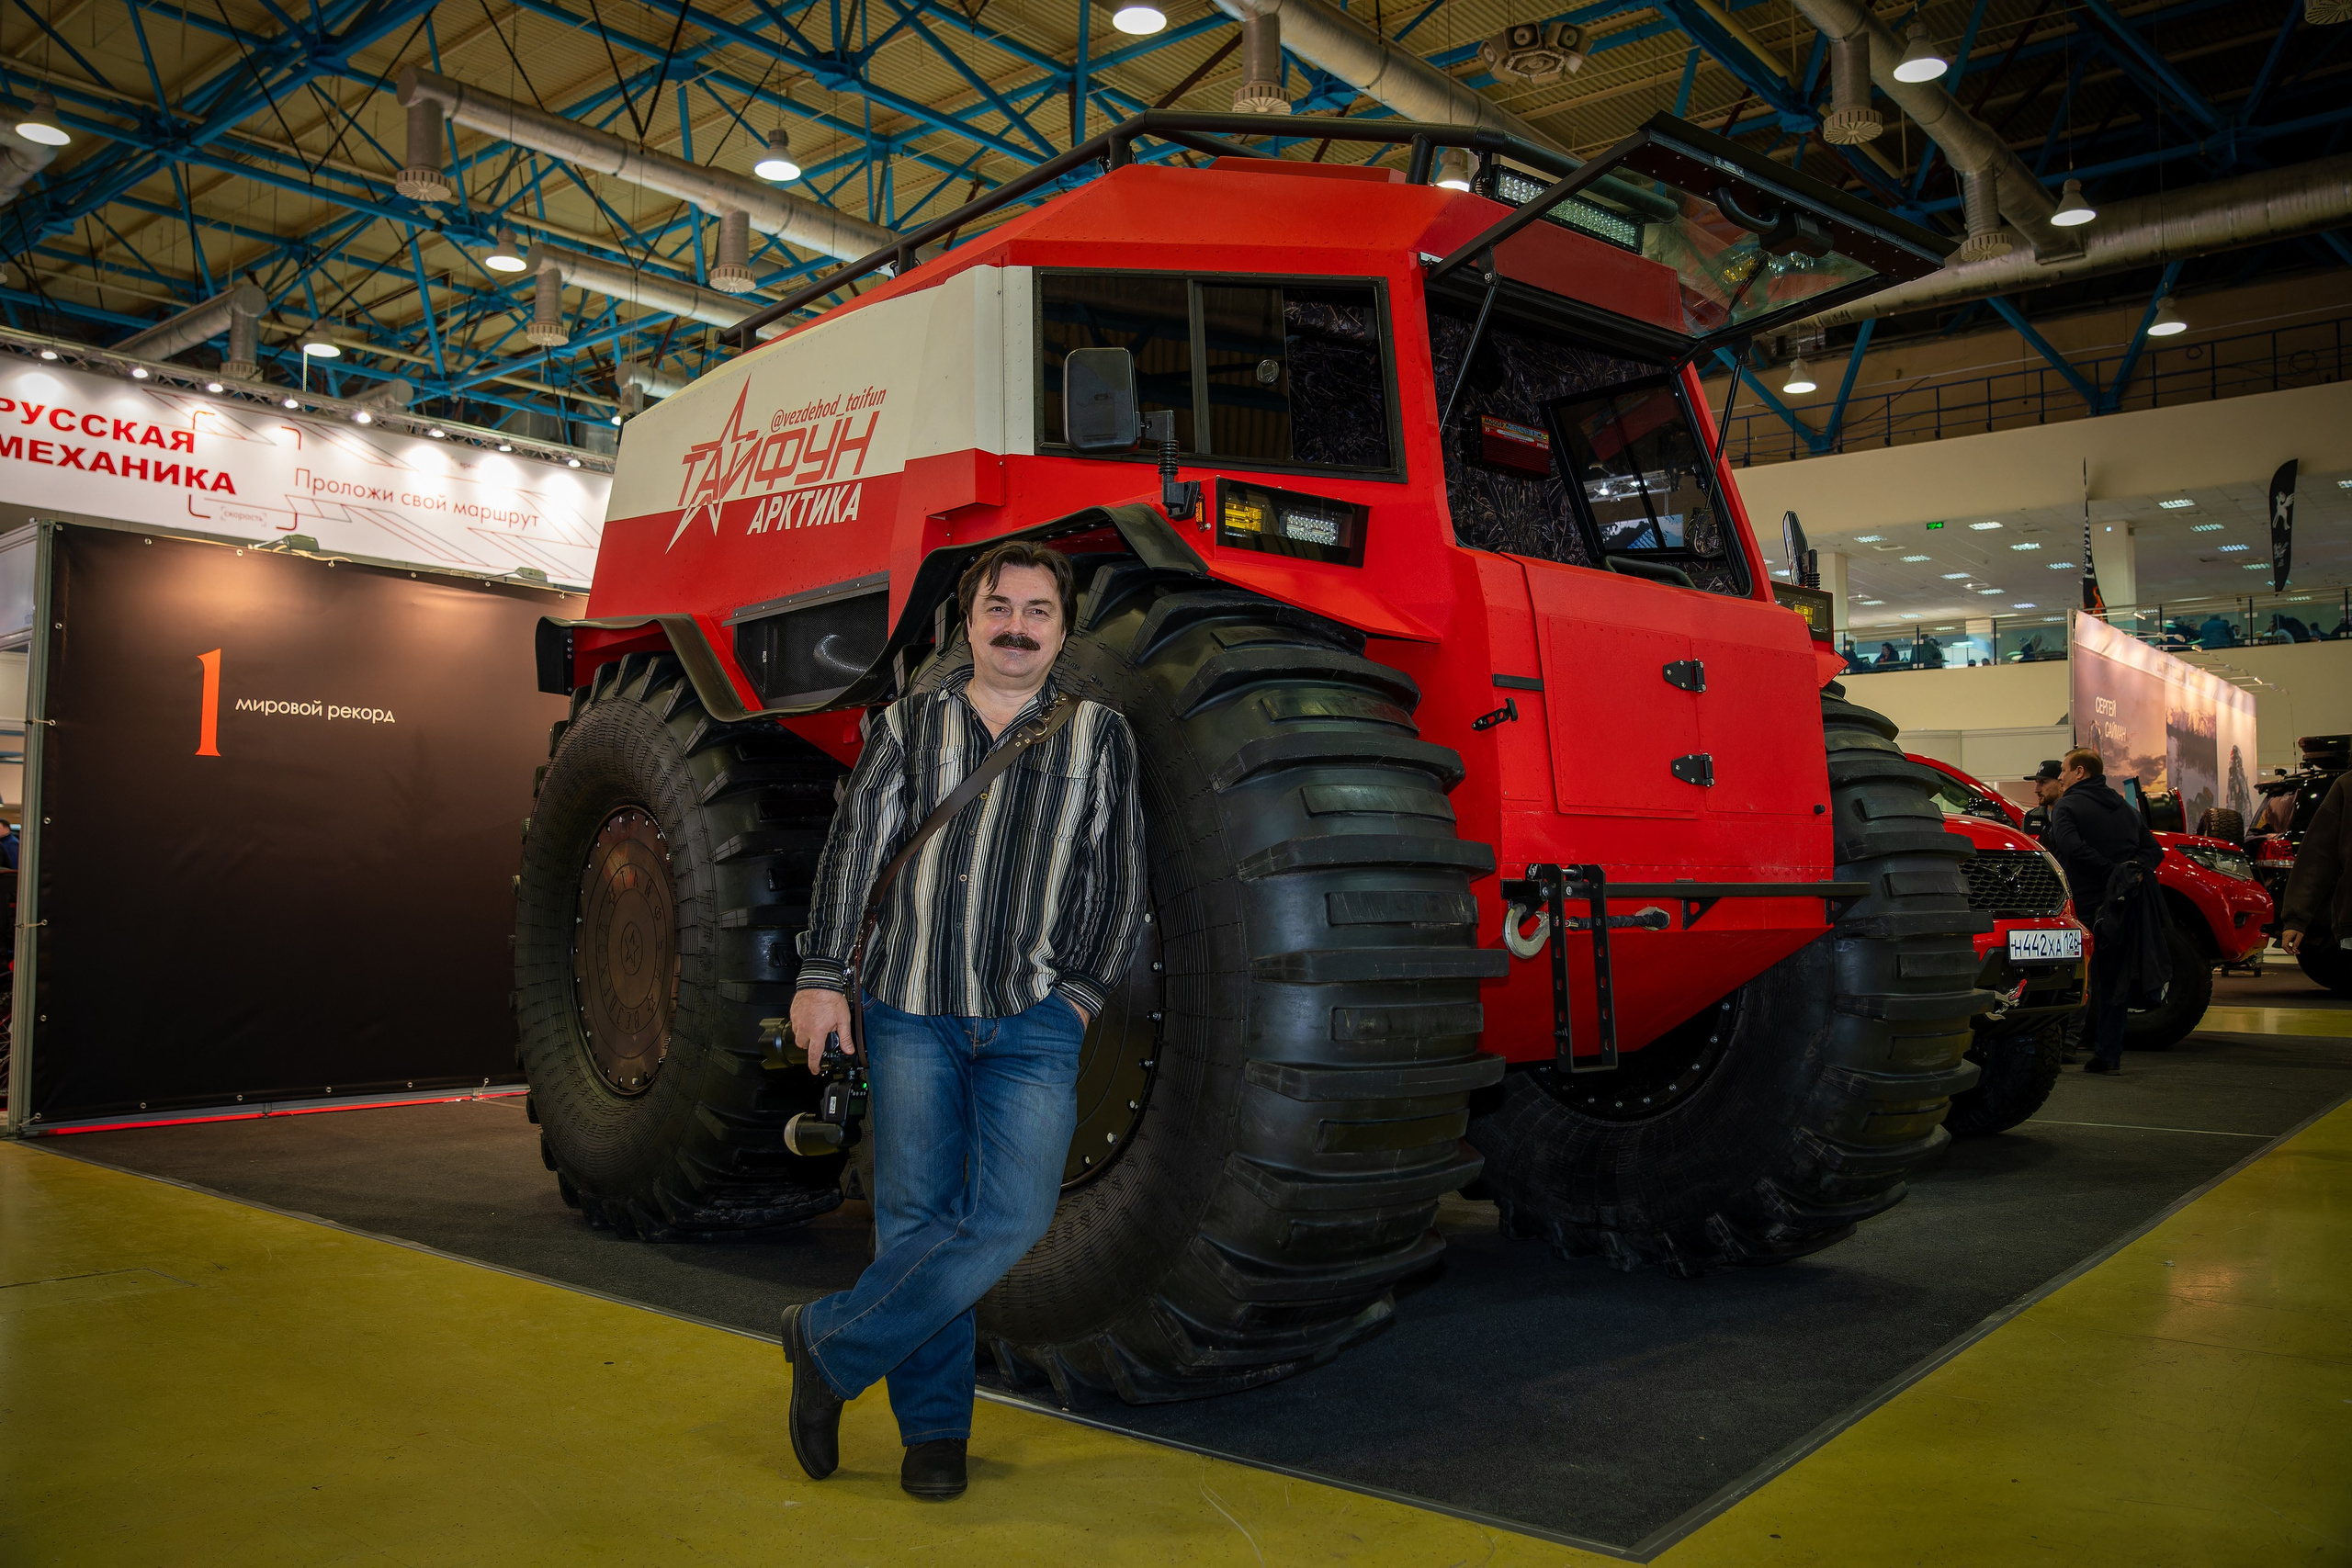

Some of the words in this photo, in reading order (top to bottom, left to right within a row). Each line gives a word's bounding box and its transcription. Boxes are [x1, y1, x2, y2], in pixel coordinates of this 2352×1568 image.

[0, 397, 195, 454] РУССКАЯ
[771, 386, 887, 434] @vezdehod_taifun
[0, 434, 237, 495] МЕХАНИКА
[295, 468, 394, 503] Проложи
[401, 491, 447, 512] свой
[453, 502, 540, 531] маршрут
[746, 482, 863, 536] АРКТИКА
[195, 648, 221, 757] 1
[235, 698, 322, 716] мировой
[327, 705, 395, 724] рекорд
[2095, 696, 2117, 718] СЕРГЕЙ
[2064, 931, 2079, 950] 126
